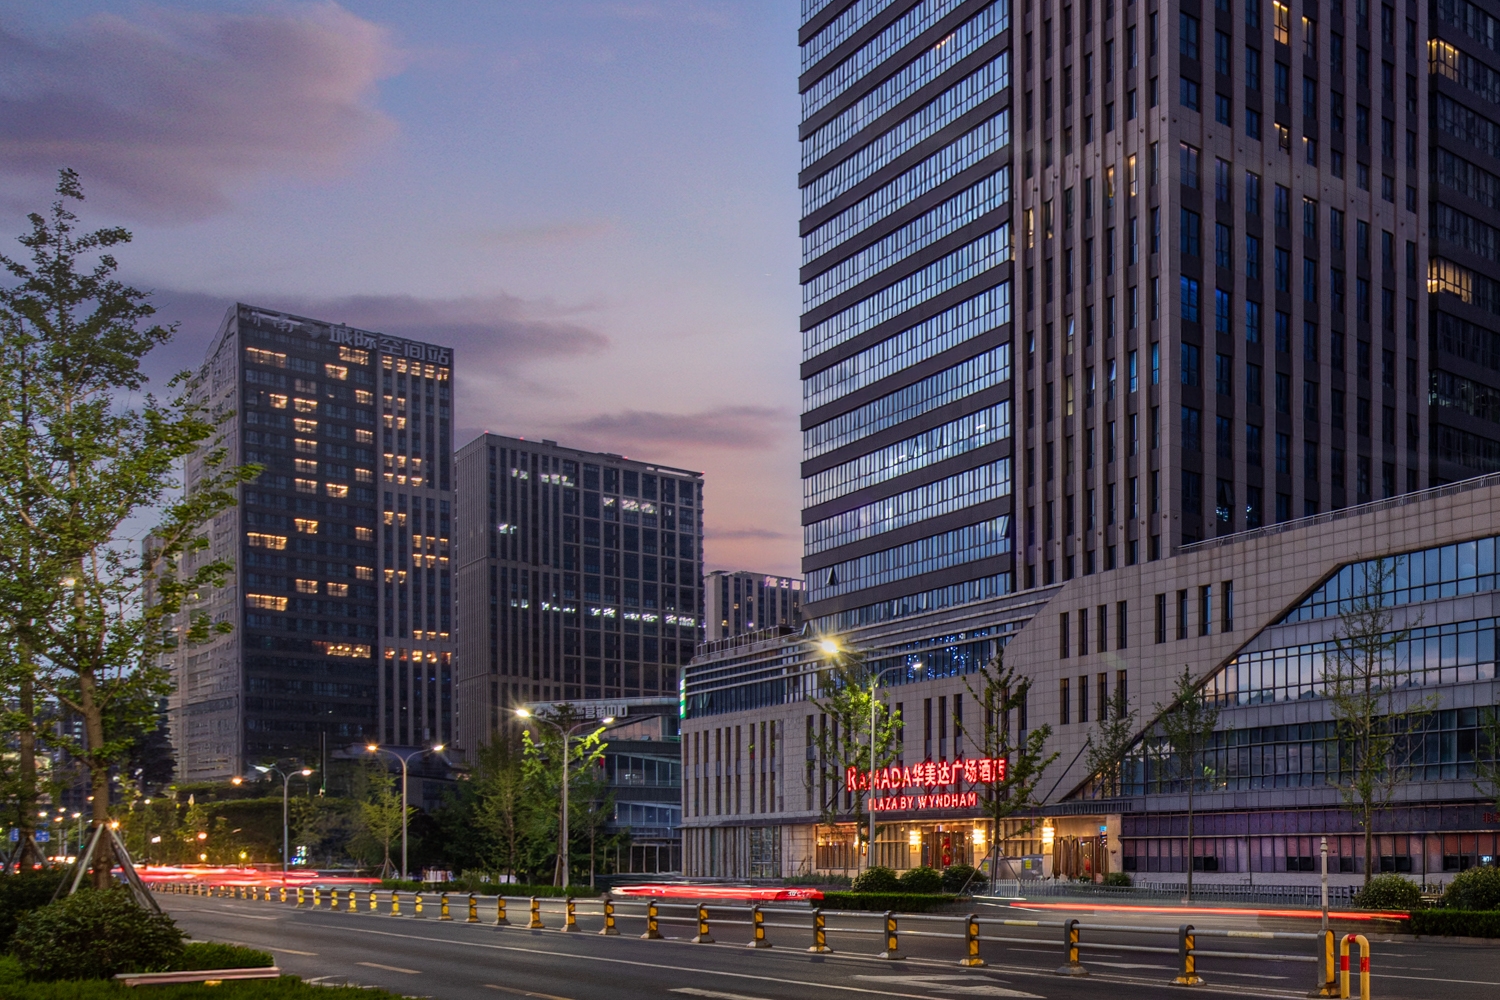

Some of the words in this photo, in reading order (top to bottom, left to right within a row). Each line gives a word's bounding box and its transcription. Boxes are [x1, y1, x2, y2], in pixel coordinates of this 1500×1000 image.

[329, 325, 450, 366] 城际空间站
[900, 796, 914, 809] BY
[917, 792, 977, 809] WYNDHAM
